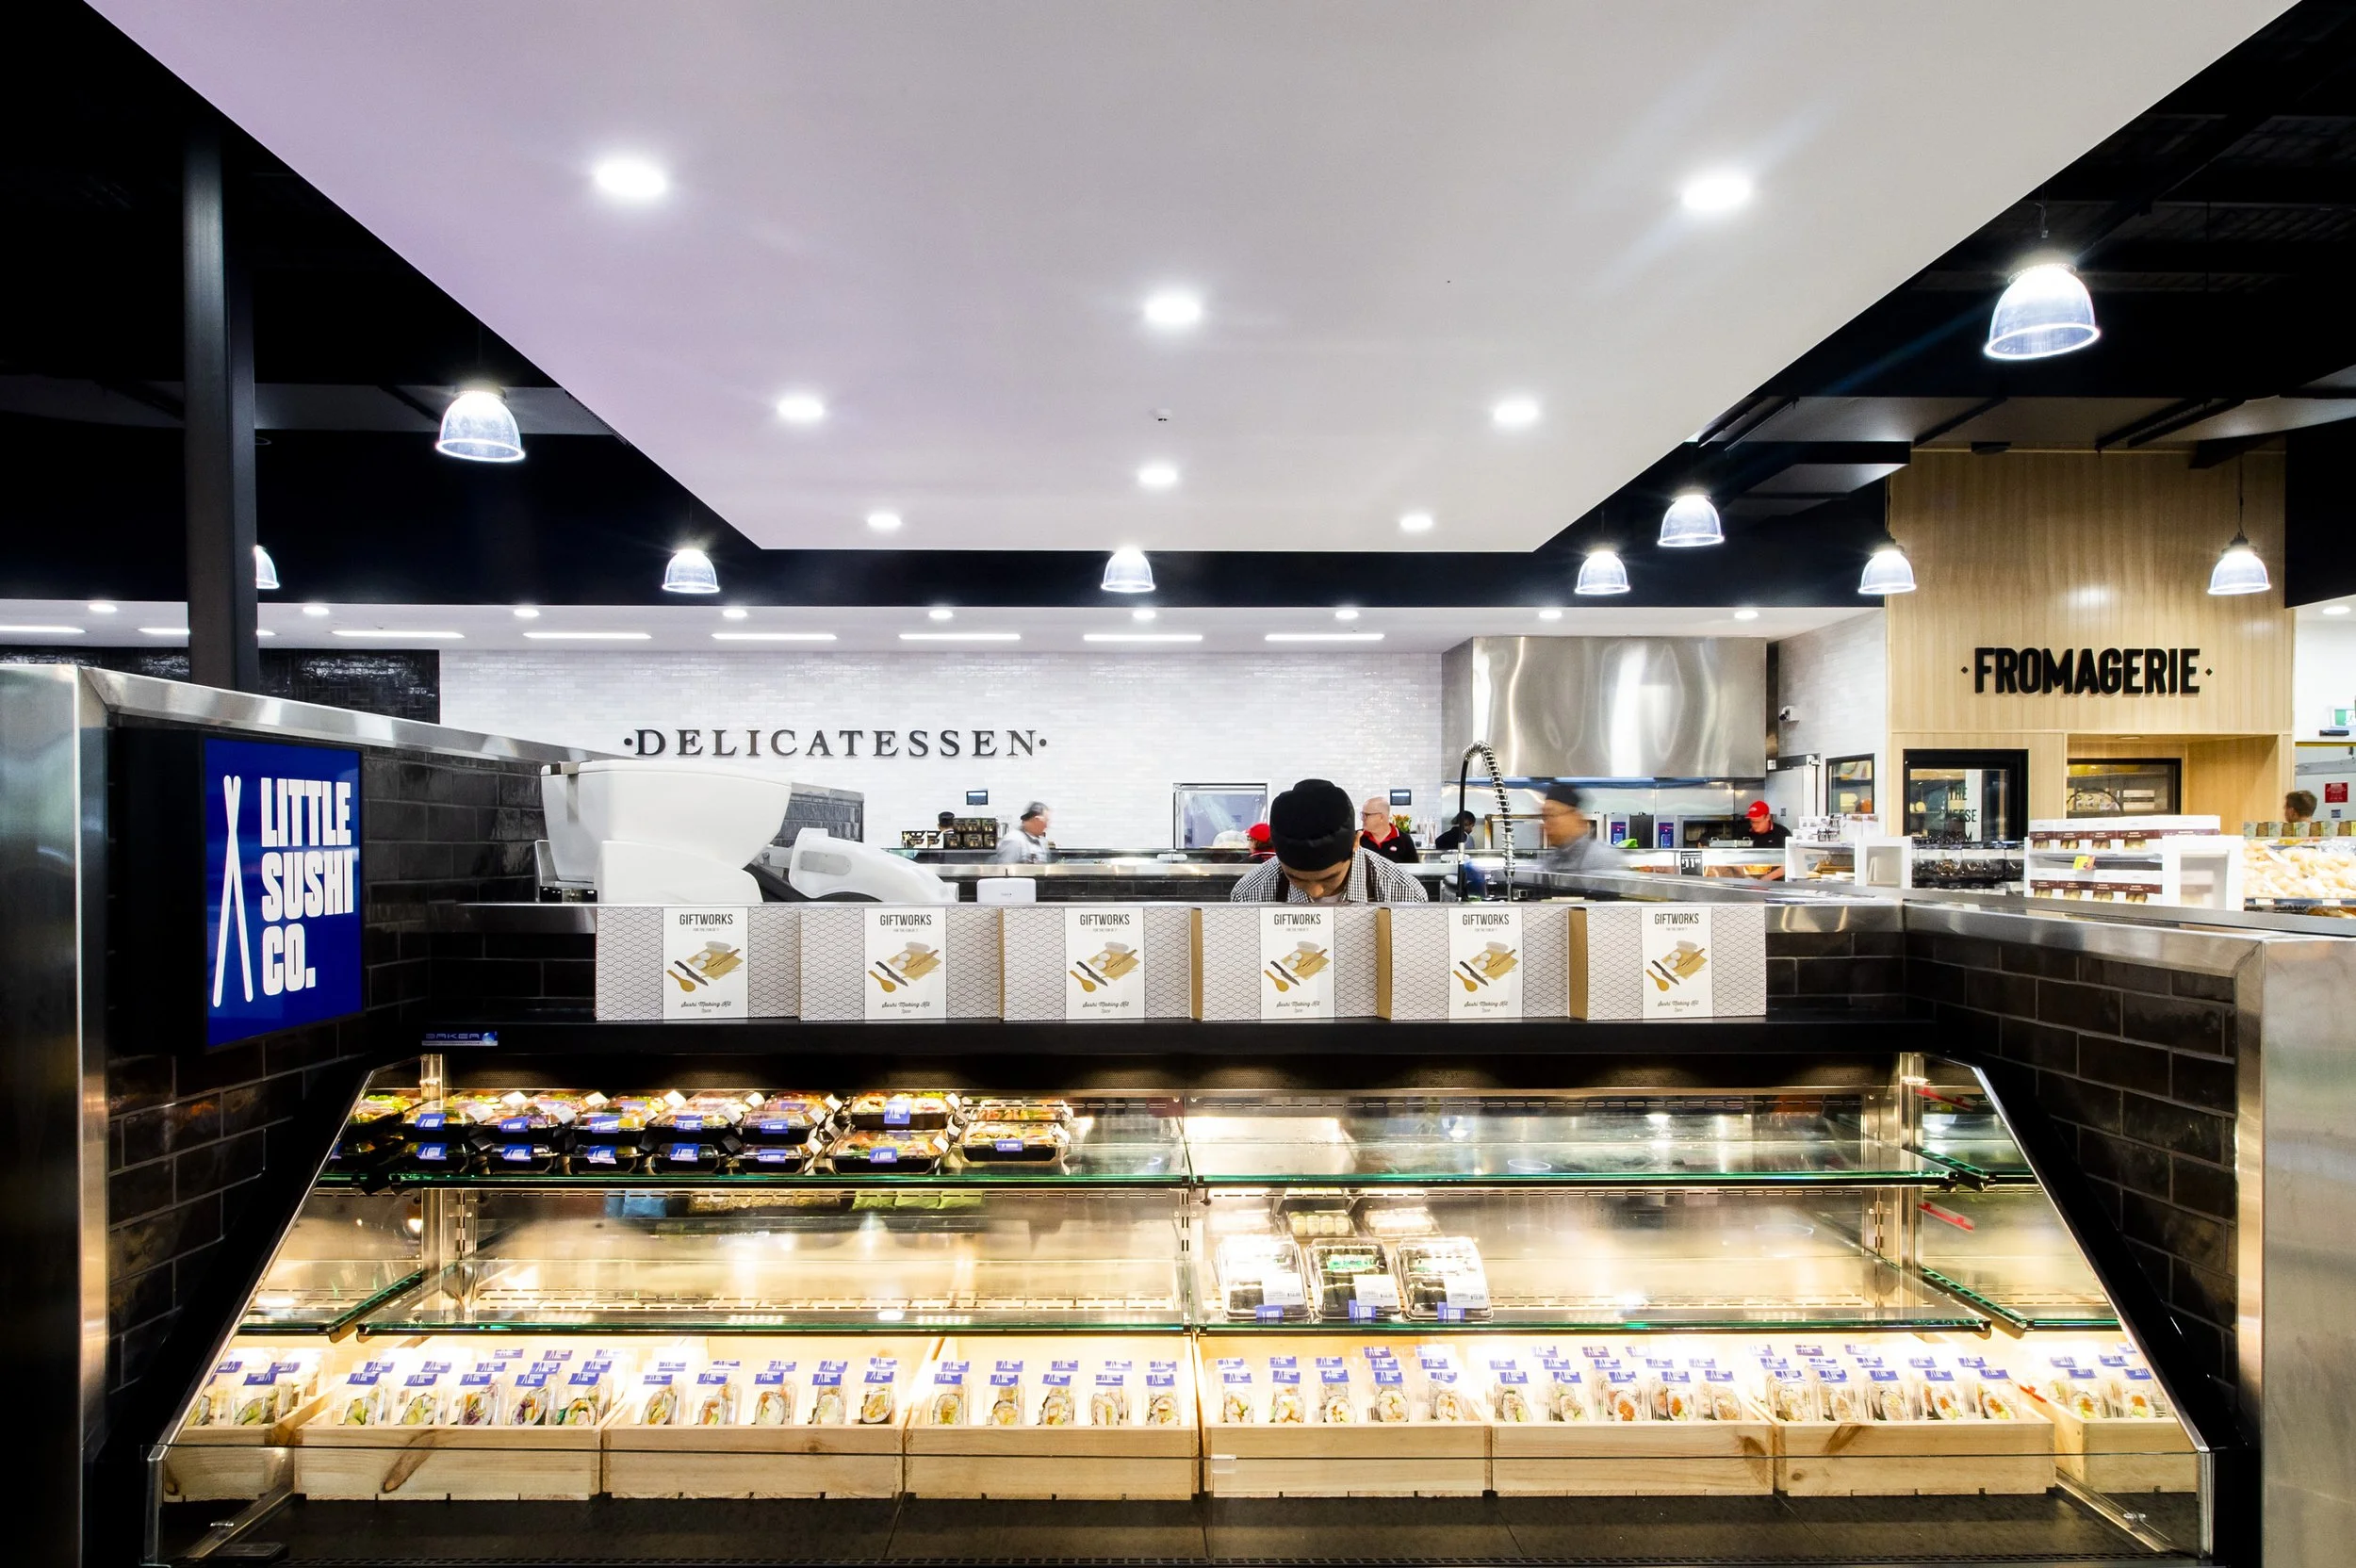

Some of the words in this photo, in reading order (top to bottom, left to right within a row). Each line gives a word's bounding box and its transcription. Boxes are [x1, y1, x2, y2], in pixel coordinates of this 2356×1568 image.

[1974, 647, 2201, 694] FROMAGERIE
[634, 728, 1036, 757] DELICATESSEN
[260, 776, 352, 848] LITTLE
[261, 850, 354, 923] SUSHI
[679, 913, 734, 925] GIFTWORKS
[879, 914, 932, 926] GIFTWORKS
[1079, 913, 1131, 925] GIFTWORKS
[1273, 913, 1321, 925] GIFTWORKS
[1462, 913, 1510, 925] GIFTWORKS
[1654, 912, 1700, 924] GIFTWORKS
[262, 923, 316, 996] CO.
